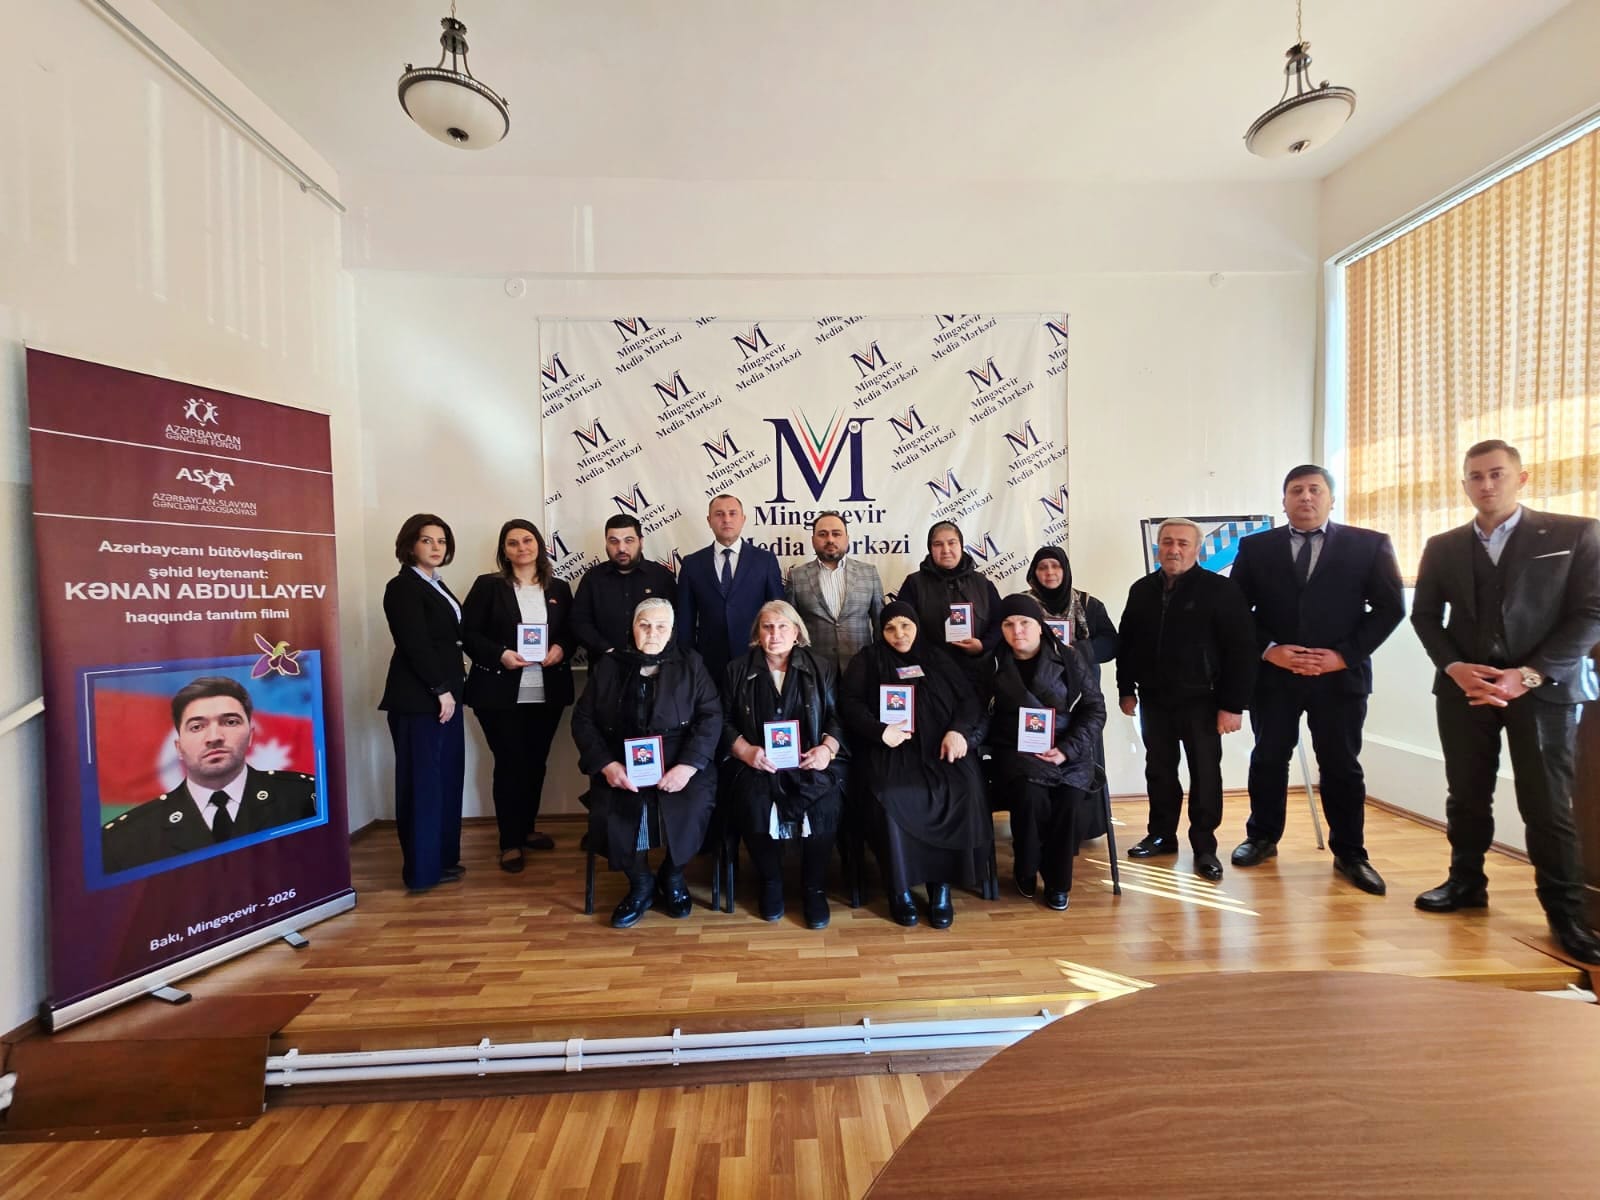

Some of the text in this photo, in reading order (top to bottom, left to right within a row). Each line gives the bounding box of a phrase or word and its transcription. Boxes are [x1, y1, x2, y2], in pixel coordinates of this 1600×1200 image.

[617, 326, 667, 359] Mingəçevir
[815, 325, 844, 345] Media
[931, 341, 960, 362] Media
[960, 317, 997, 344] Mərkəzi
[615, 332, 683, 375] Media Mərkəzi
[735, 349, 803, 392] Media Mərkəzi
[737, 342, 787, 376] Mingəçevir
[853, 367, 919, 410] Media Mərkəzi
[855, 361, 903, 394] Mingəçevir
[971, 376, 1019, 410] Mingəçevir
[542, 379, 603, 418] edia Mərkəzi
[657, 389, 707, 424] Mingəçevir
[969, 381, 1035, 427] Media Mərkəzi
[656, 395, 723, 439] Media Mərkəzi
[577, 437, 627, 471] Mingəçevir
[891, 428, 957, 474] Media Mərkəzi
[893, 425, 941, 458] Mingəçevir
[1008, 441, 1056, 473] Mingəçevir
[576, 443, 643, 487] Media Mərkəzi
[705, 454, 772, 499] Media Mərkəzi
[706, 449, 756, 483] Mingəçevir
[1007, 469, 1035, 489] Media
[644, 509, 682, 535] Mərkəzi
[754, 504, 887, 530] Mingevir
[98, 540, 304, 561] Azərbaycanı bütövləşdirən
[814, 534, 911, 557] rkəzi
[149, 566, 269, 580] şəhid leytenant:
[65, 582, 327, 601] KƏNAN ABDULLAYEV
[126, 609, 290, 625] haqqında tanıtım filmi
[150, 934, 185, 951] Bakı,
[187, 903, 258, 938] Mingəçevir
[267, 888, 297, 907] 2026
